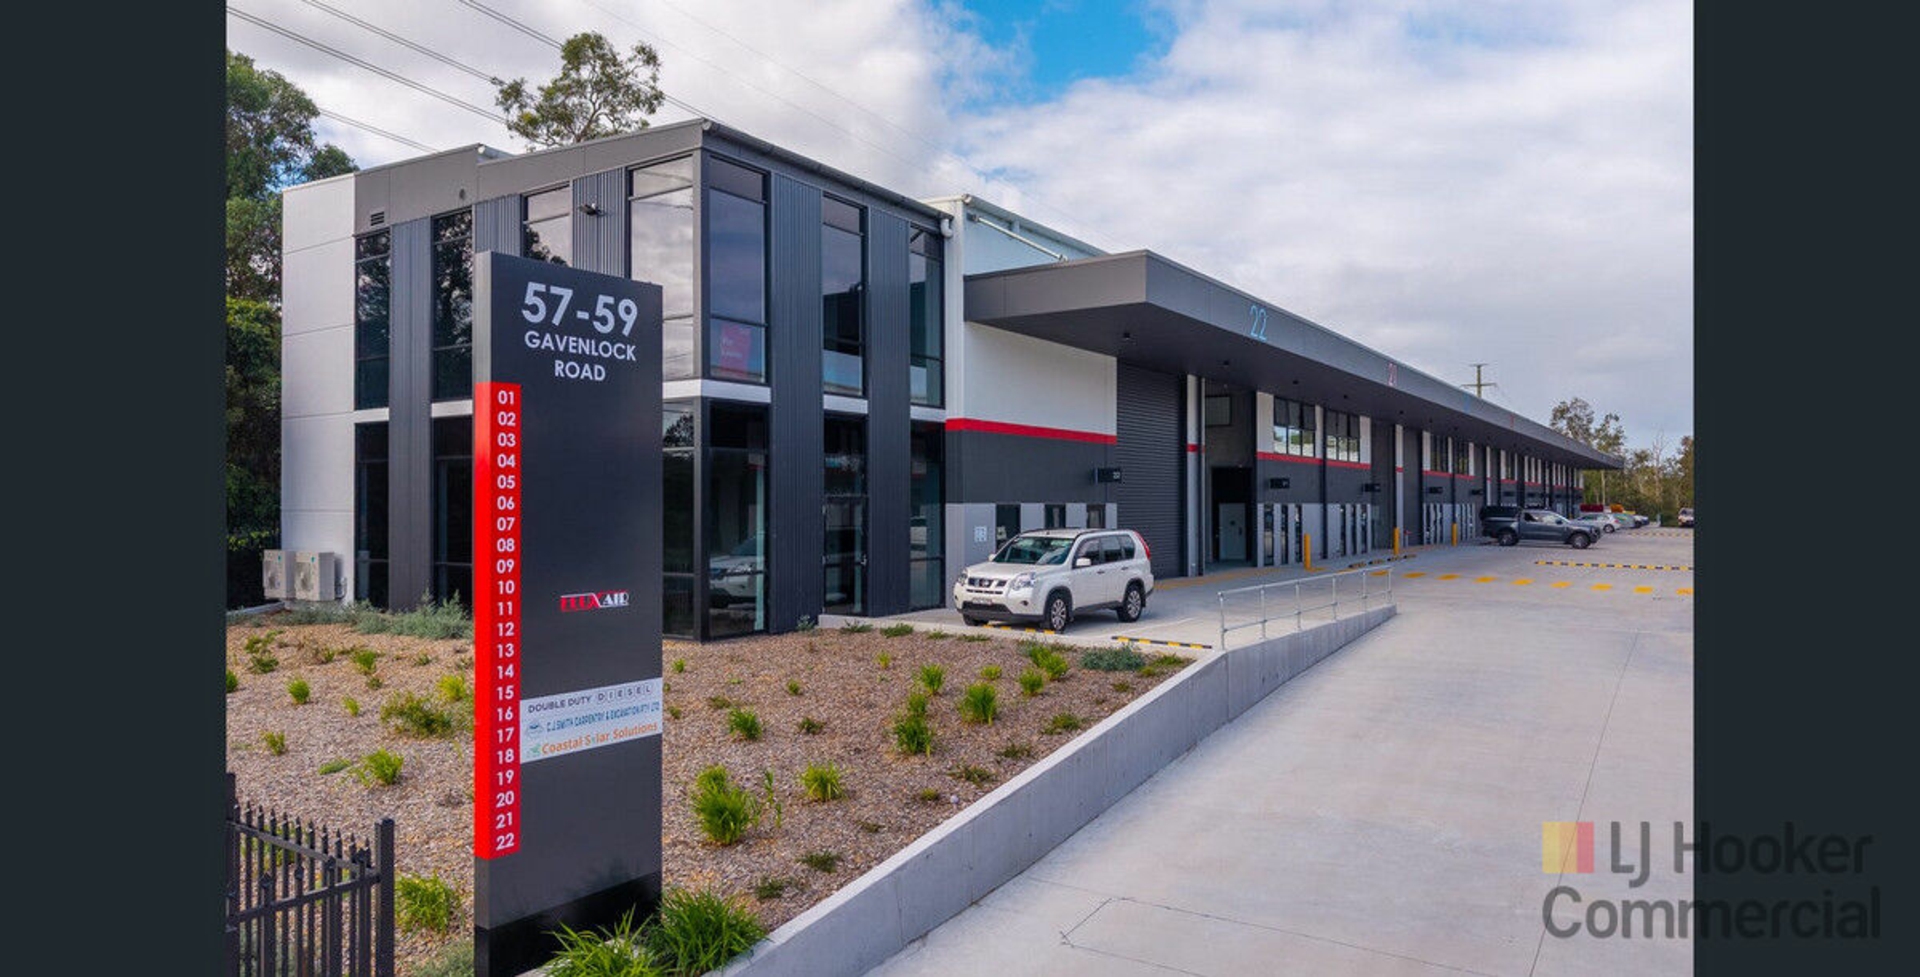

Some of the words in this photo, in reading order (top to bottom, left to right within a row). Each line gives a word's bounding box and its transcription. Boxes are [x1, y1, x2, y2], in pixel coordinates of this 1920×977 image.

[522, 281, 638, 337] 57-59
[1250, 305, 1267, 341] 22
[524, 331, 637, 362] GAVENLOCK
[554, 360, 606, 381] ROAD
[498, 390, 514, 405] 01
[497, 411, 516, 427] 02
[497, 432, 516, 447] 03
[497, 453, 515, 468] 04
[497, 474, 515, 489] 05
[497, 496, 515, 510] 06
[497, 517, 515, 531] 07
[497, 538, 515, 552] 08
[496, 559, 515, 574] 09
[498, 580, 515, 595] 10
[498, 601, 513, 616] 11
[498, 622, 515, 637] 12
[497, 643, 514, 658] 13
[497, 664, 514, 679] 14
[497, 685, 514, 701] 15
[528, 699, 566, 713] DOUBLE
[568, 695, 592, 706] DUTY
[597, 684, 651, 701] DIESEL
[497, 706, 513, 722] 16
[497, 727, 514, 743] 17
[542, 736, 583, 755] Coastal
[613, 721, 658, 739] Solutions
[497, 748, 514, 764] 18
[497, 769, 514, 785] 19
[496, 790, 515, 808] 20
[496, 811, 513, 830] 21
[496, 832, 514, 851] 22
